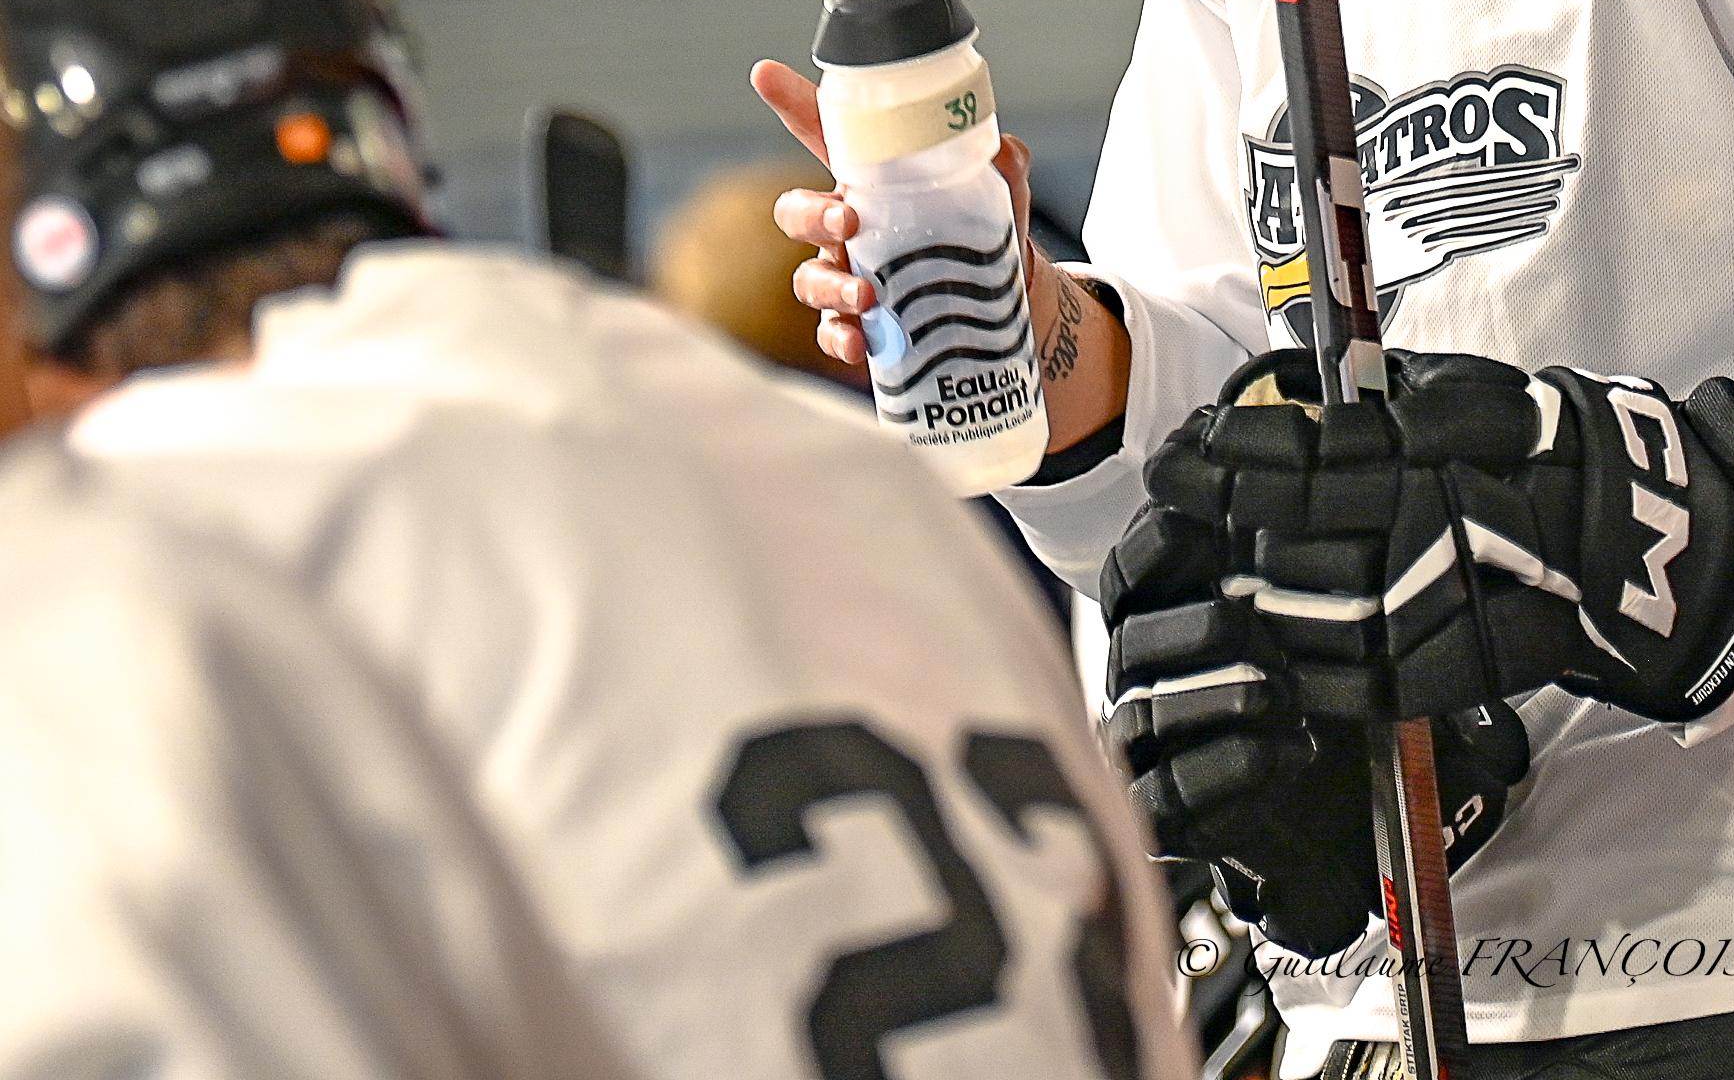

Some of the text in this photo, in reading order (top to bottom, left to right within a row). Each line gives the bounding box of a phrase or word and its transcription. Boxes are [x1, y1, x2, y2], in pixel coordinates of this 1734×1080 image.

[944, 89, 977, 131] 39
[1257, 87, 1551, 246] AATROS
[923, 376, 1029, 431] Ponant
[936, 365, 1020, 403] Eau du
[908, 430, 951, 447] Société
[951, 423, 1004, 445] Publique
[1691, 665, 1729, 706] FLEXCUFF
[1397, 983, 1408, 1017] GRIP
